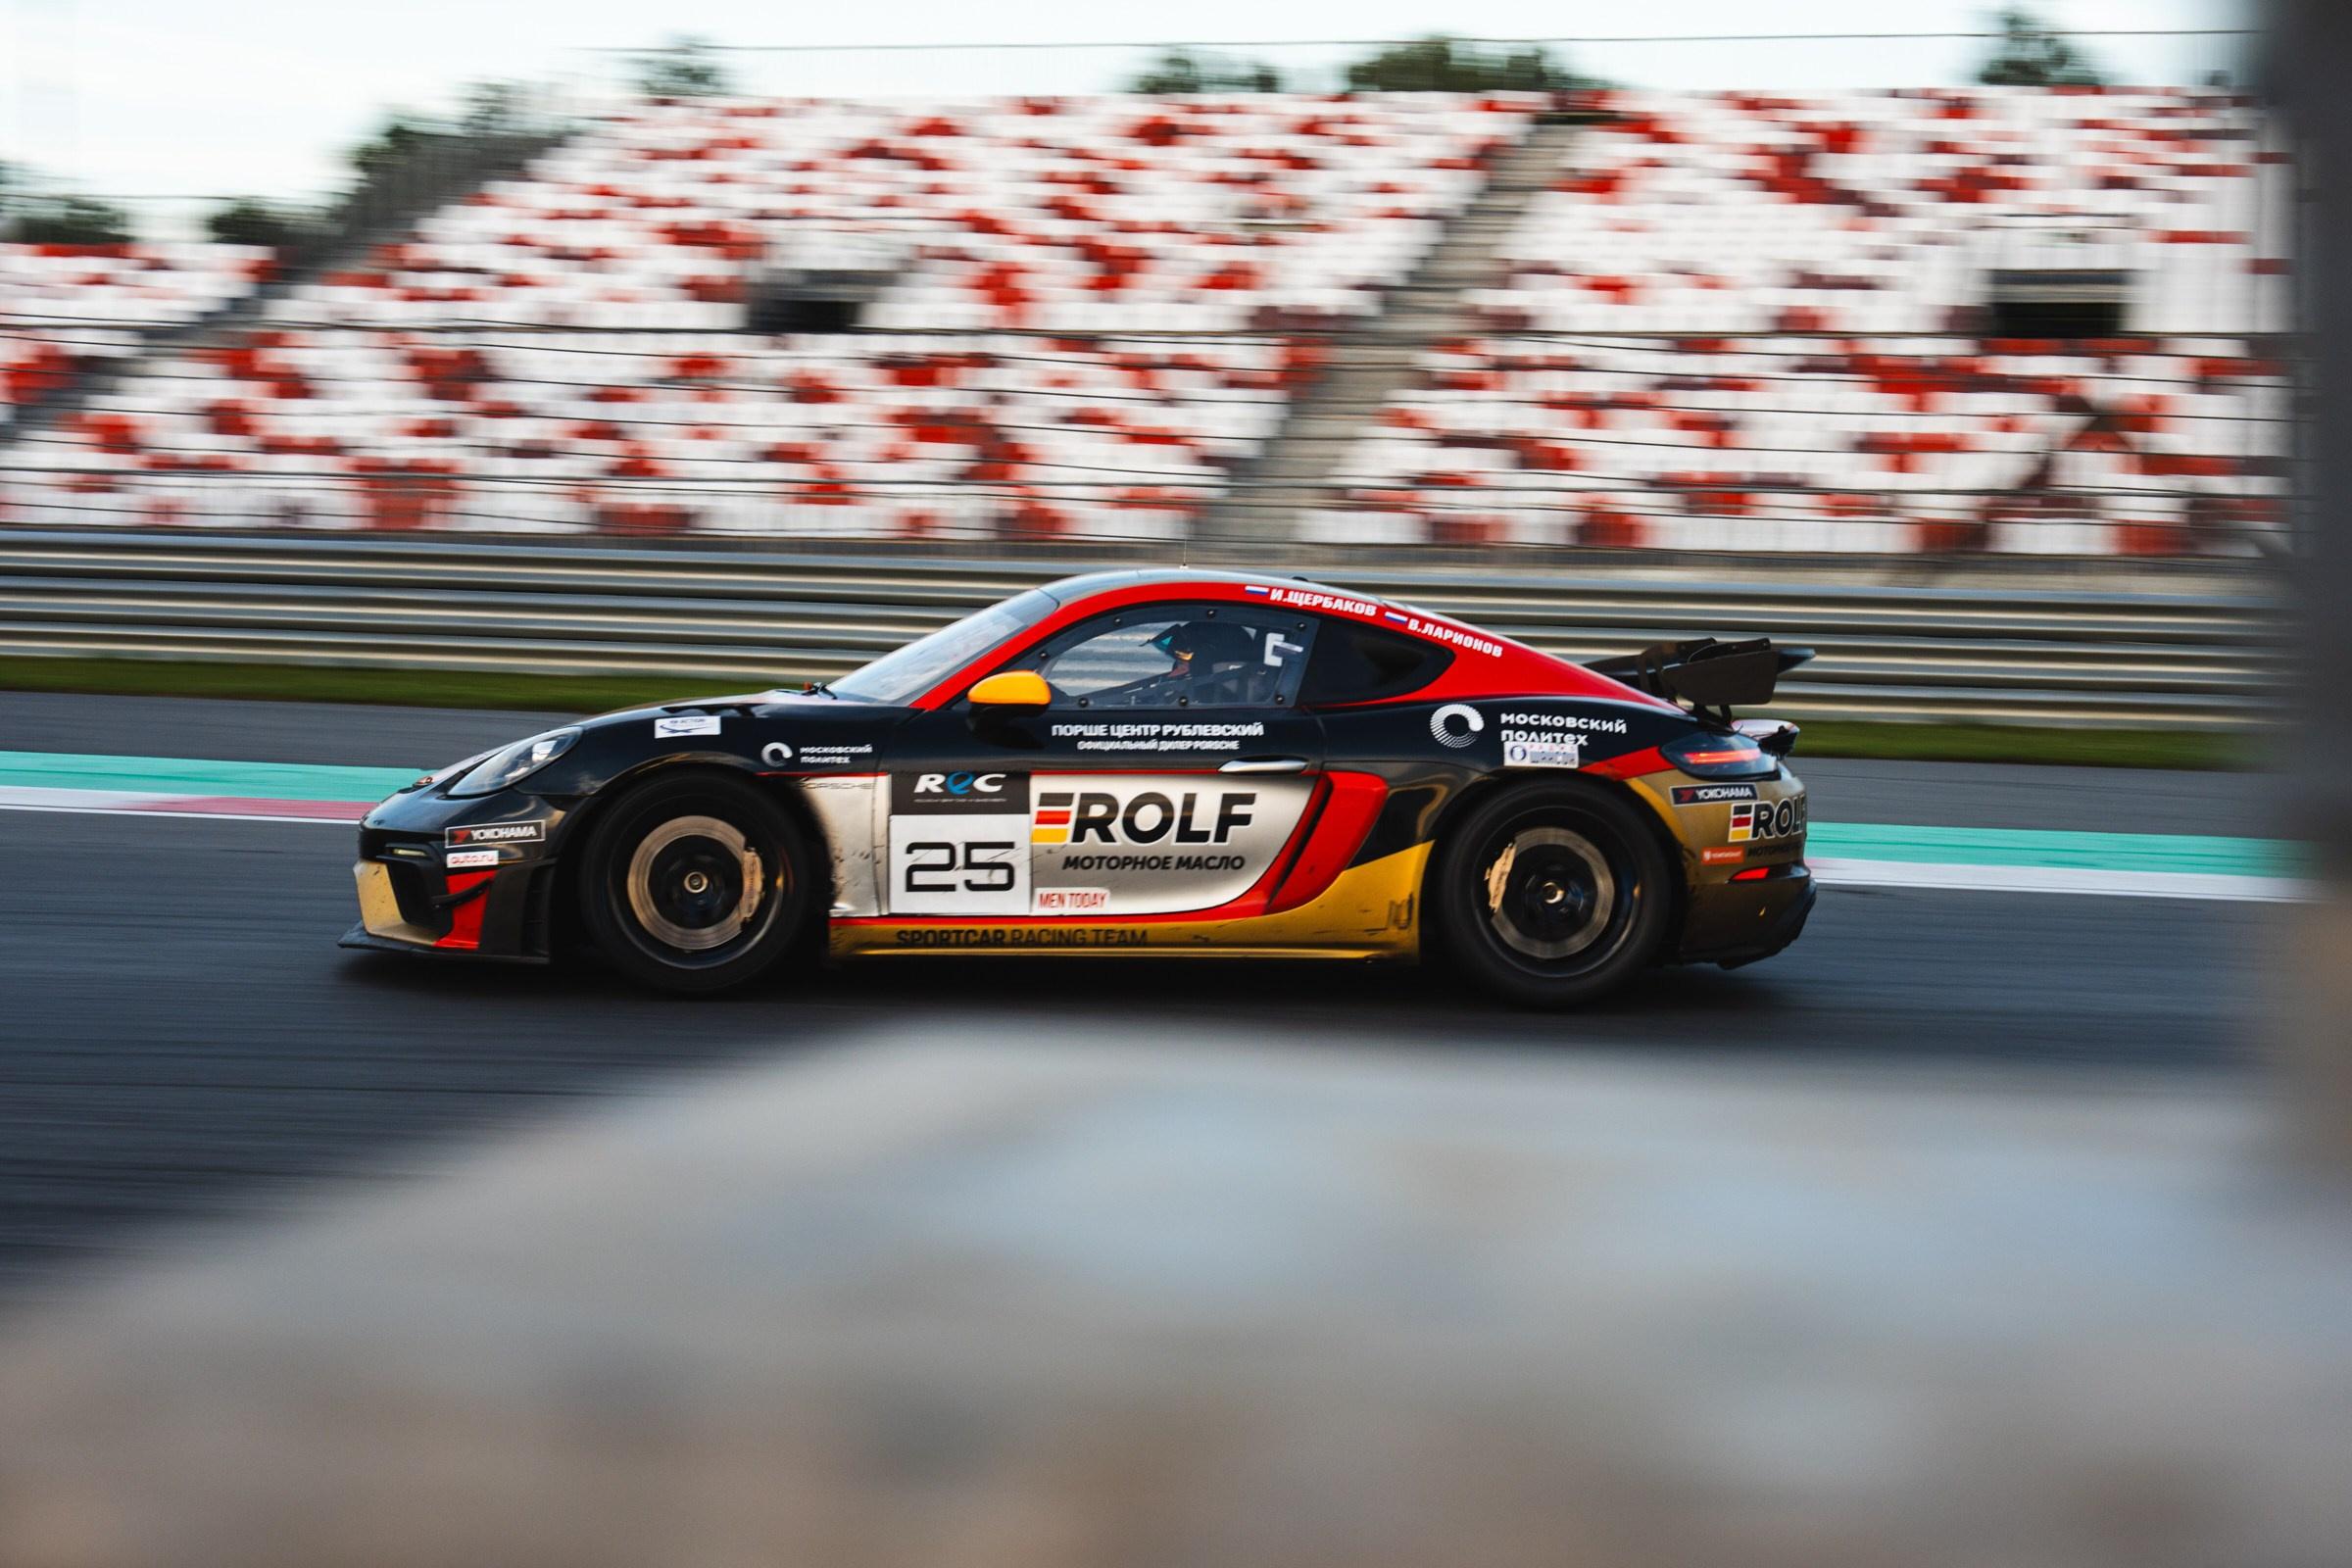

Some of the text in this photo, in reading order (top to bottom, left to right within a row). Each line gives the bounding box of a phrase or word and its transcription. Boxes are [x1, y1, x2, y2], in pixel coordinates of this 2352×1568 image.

[1270, 588, 1377, 616] И.ЩЕРБАКОВ
[1407, 618, 1503, 658] В.ЛАРИОНОВ
[1052, 722, 1265, 738] ПОРШЕ ЦЕНТР РУБЛЕВСКИЙ
[1077, 739, 1157, 751] ОФИЦИАЛЬНЫЙ
[1158, 740, 1193, 752] ДИЛЕР
[1695, 787, 1753, 800] YOKOHAMA
[1071, 791, 1257, 845] ROLF
[470, 825, 538, 841] YOKOHAMA
[906, 841, 1015, 893] 25
[1062, 855, 1247, 871] МОТОРНОЕ МАСЛО
[1039, 893, 1108, 908] MEN TODAY
[895, 928, 1149, 948] SPORTCAR RACING TEAM
